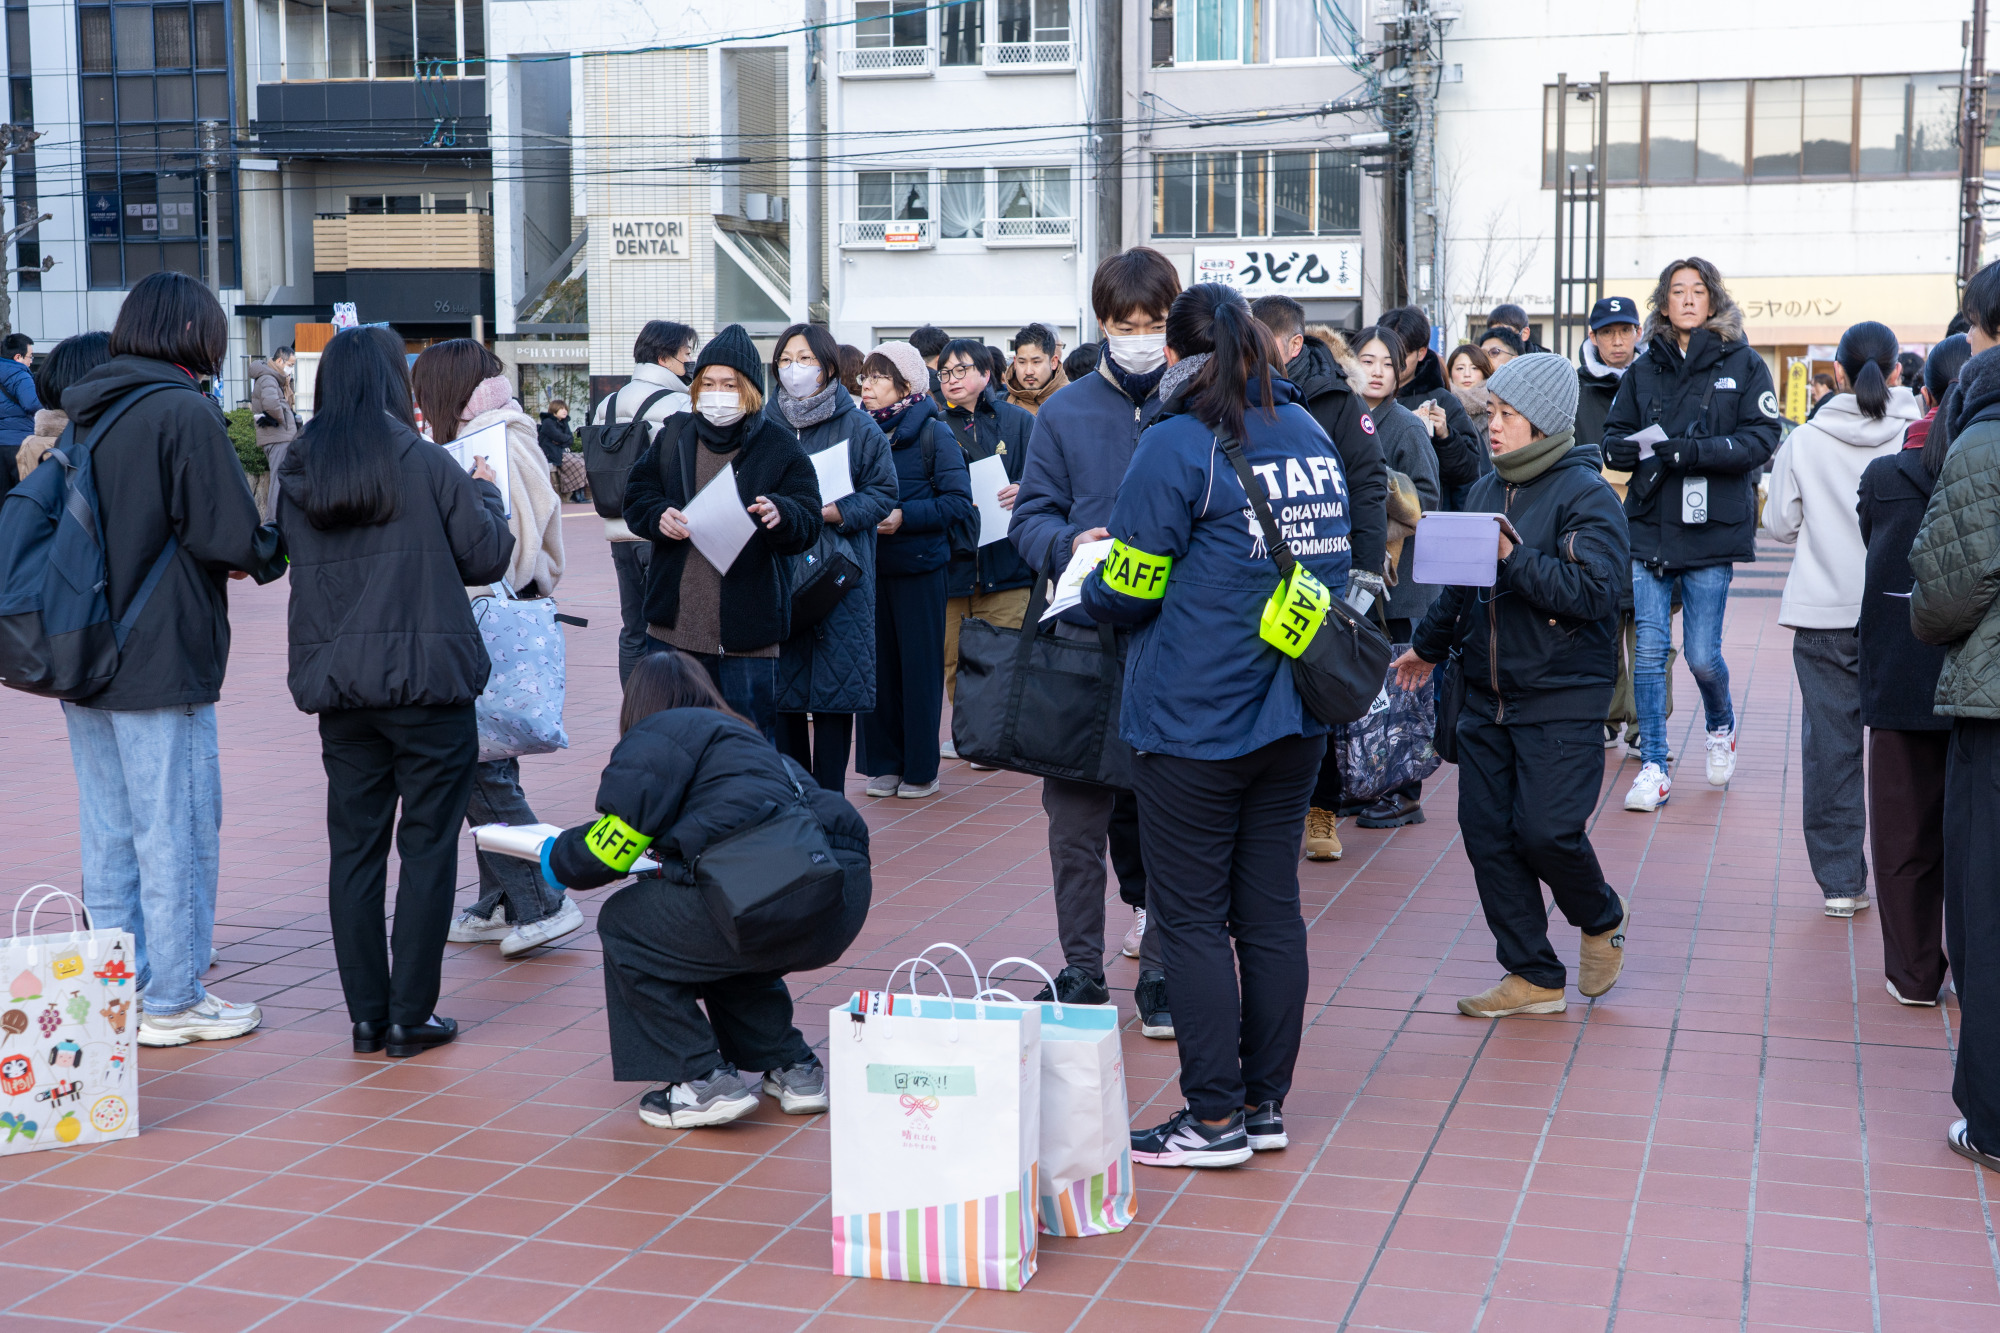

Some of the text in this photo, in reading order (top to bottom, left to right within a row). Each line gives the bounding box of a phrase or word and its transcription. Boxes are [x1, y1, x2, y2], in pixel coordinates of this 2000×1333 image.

[612, 221, 682, 237] HATTORI
[616, 239, 679, 254] DENTAL
[1239, 252, 1329, 285] うどん
[1200, 272, 1233, 283] 手打ち
[434, 300, 469, 315] 96 bldg
[1610, 300, 1621, 312] S
[530, 348, 589, 358] HATTORI
[1238, 456, 1346, 500] TAFF
[1281, 502, 1343, 523] OKAYAMA
[1281, 522, 1315, 540] FILM
[1287, 535, 1351, 556] OMMISSIO
[1372, 700, 1388, 711] BAPE
[591, 814, 637, 860] AFF
[902, 1130, 936, 1142] 晴ればれ
